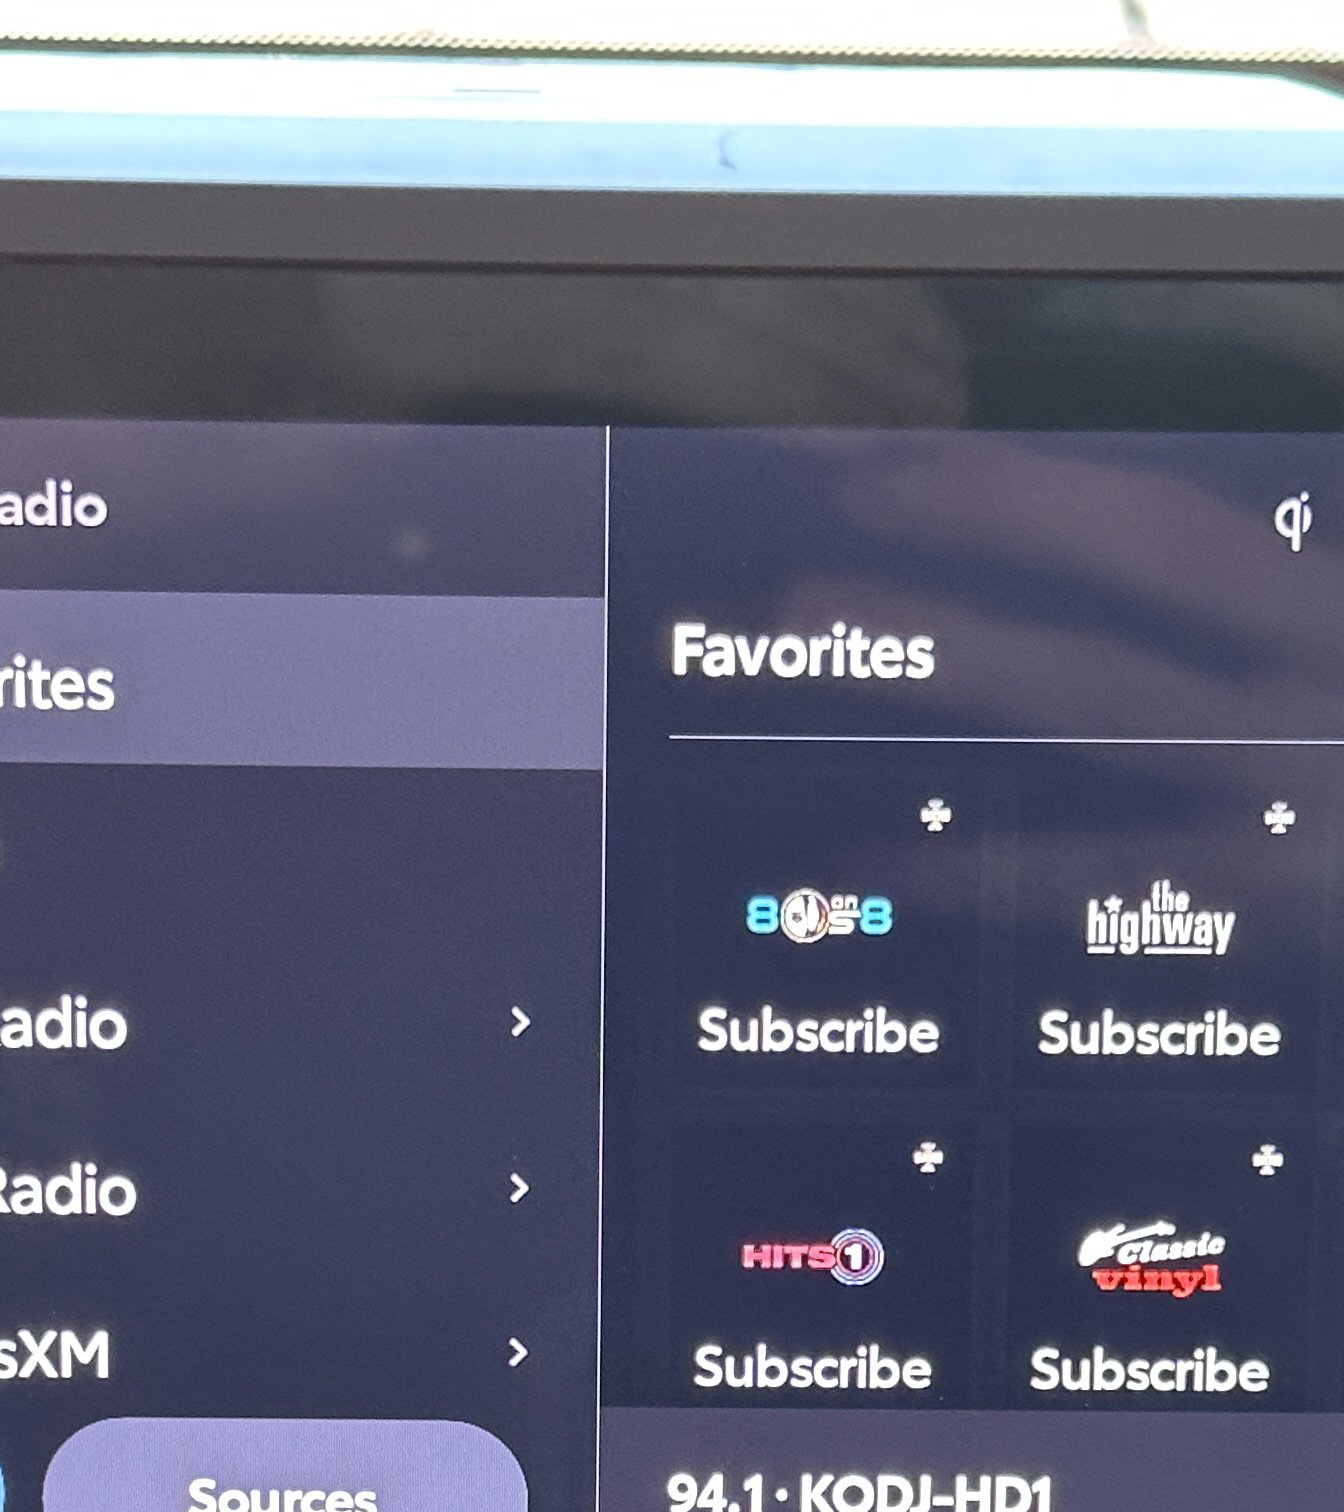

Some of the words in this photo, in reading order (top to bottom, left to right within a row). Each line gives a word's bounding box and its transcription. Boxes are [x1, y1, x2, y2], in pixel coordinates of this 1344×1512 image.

[673, 620, 935, 679] Favorites
[1151, 879, 1190, 912] the
[1087, 895, 1236, 955] highway
[697, 1004, 940, 1054] Subscribe
[1038, 1007, 1282, 1056] Subscribe
[1091, 1263, 1222, 1298] vinyl
[693, 1342, 932, 1389] Subscribe
[1030, 1345, 1270, 1392] Subscribe
